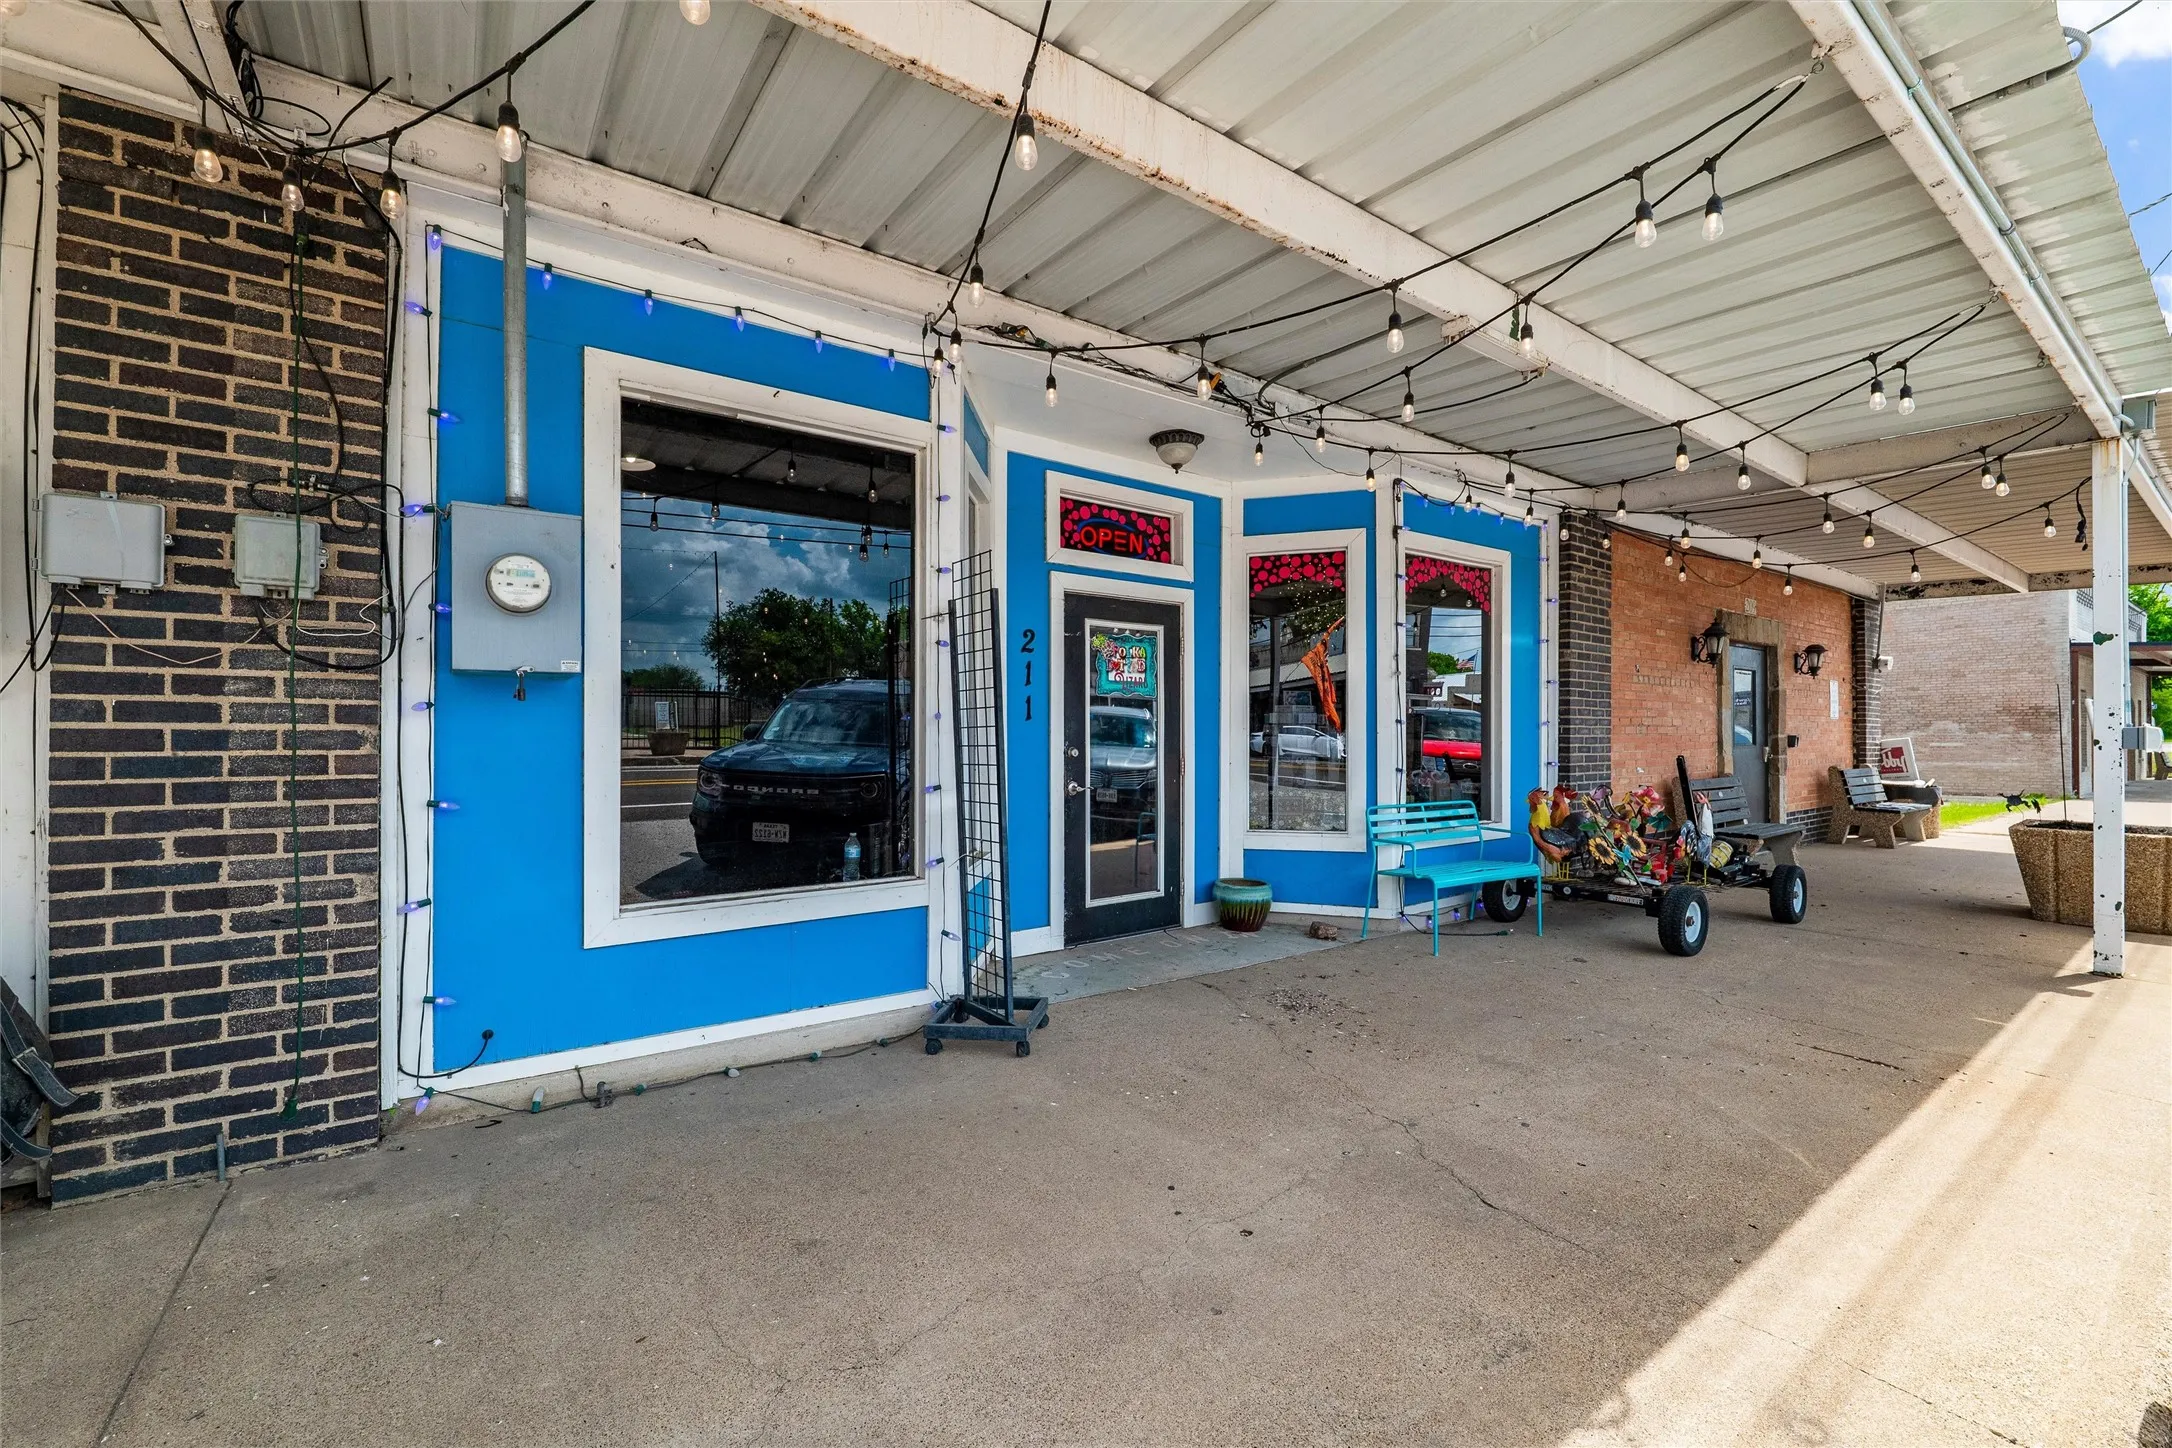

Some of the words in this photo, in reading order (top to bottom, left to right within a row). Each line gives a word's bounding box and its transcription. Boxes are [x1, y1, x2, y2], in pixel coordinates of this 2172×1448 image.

[1080, 526, 1143, 554] OPEN
[1019, 628, 1036, 722] 211
[1881, 749, 1907, 773] bby
